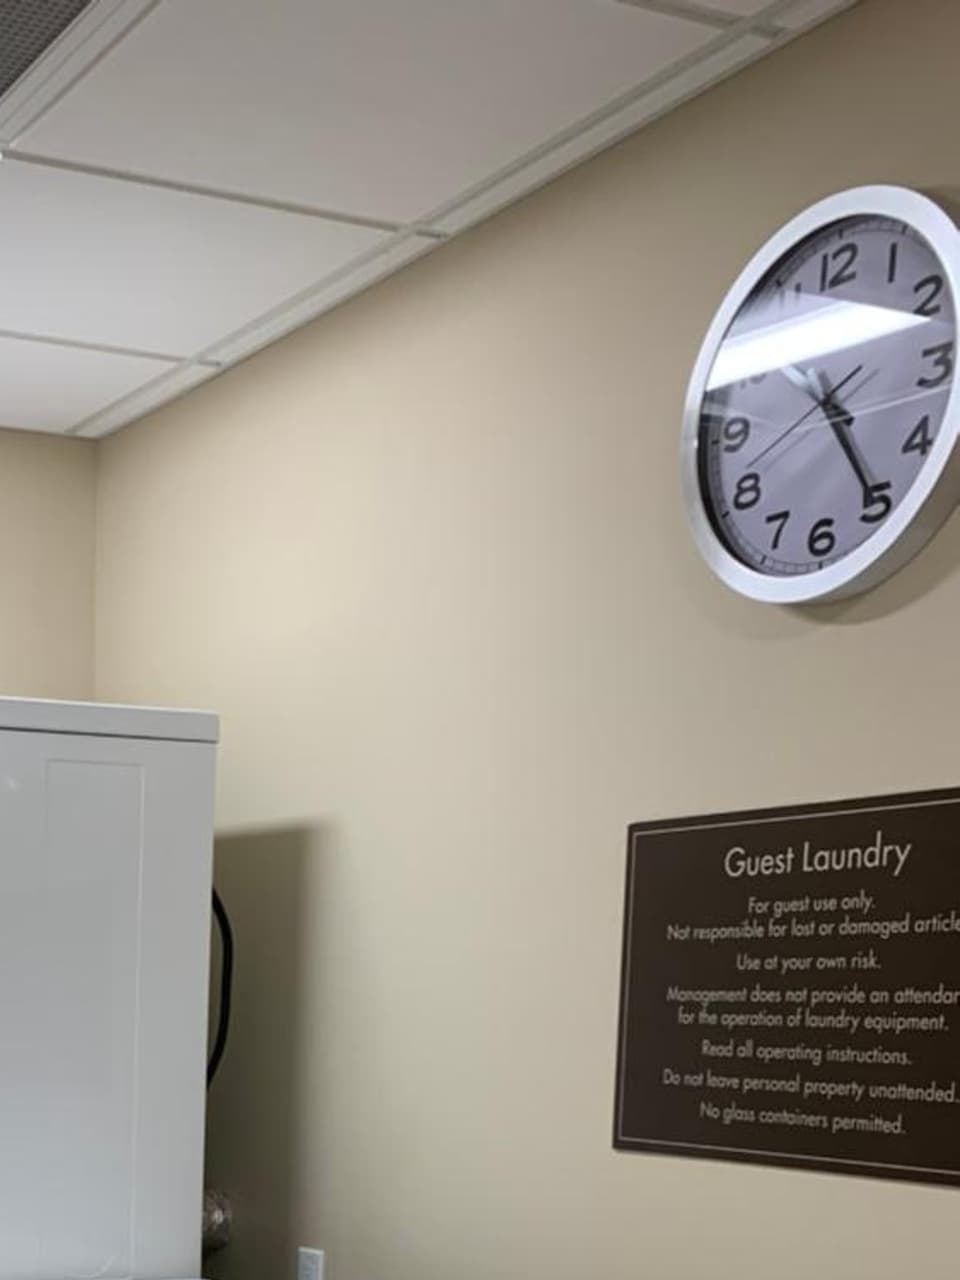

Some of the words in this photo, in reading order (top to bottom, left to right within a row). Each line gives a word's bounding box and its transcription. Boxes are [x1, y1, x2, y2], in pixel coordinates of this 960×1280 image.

[819, 243, 859, 292] 12
[887, 242, 899, 284] 1
[912, 274, 945, 317] 2
[917, 341, 954, 389] 3
[722, 416, 751, 453] 9
[901, 415, 933, 457] 4
[732, 472, 762, 512] 8
[859, 481, 892, 525] 5
[765, 510, 791, 551] 7
[807, 518, 836, 558] 6
[724, 846, 795, 877] Guest
[802, 830, 912, 877] Laundry
[748, 897, 768, 914] For
[774, 896, 810, 918] guest
[813, 897, 837, 911] use
[841, 889, 876, 914] only.
[666, 924, 690, 941] Not
[693, 920, 764, 943] responsible
[768, 918, 787, 937] for
[791, 917, 815, 936] lost
[819, 922, 836, 936] or
[839, 913, 910, 939] damaged
[736, 954, 760, 970] Use
[764, 955, 778, 970] at
[781, 956, 812, 975] your
[816, 955, 846, 969] own
[851, 949, 881, 969] risk.
[666, 986, 747, 1008] Management
[750, 984, 781, 1002] does
[785, 988, 807, 1002] not
[811, 984, 866, 1007] provide
[869, 989, 889, 1004] an
[678, 1006, 694, 1025] for
[698, 1006, 717, 1025] the
[721, 1010, 783, 1029] operation
[787, 1009, 803, 1027] of
[805, 1009, 860, 1034] laundry
[864, 1011, 949, 1034] equipment.
[701, 1039, 733, 1057] Read
[737, 1039, 753, 1058] all
[756, 1043, 822, 1066] operating
[826, 1045, 912, 1065] instructions.
[663, 1068, 681, 1085] Do
[684, 1072, 703, 1086] not
[707, 1069, 739, 1089] leave
[743, 1074, 800, 1096] personal
[804, 1080, 865, 1102] property
[699, 1102, 720, 1119] No
[723, 1102, 755, 1125] glass
[759, 1107, 828, 1128] containers
[832, 1114, 906, 1134] permitted.
